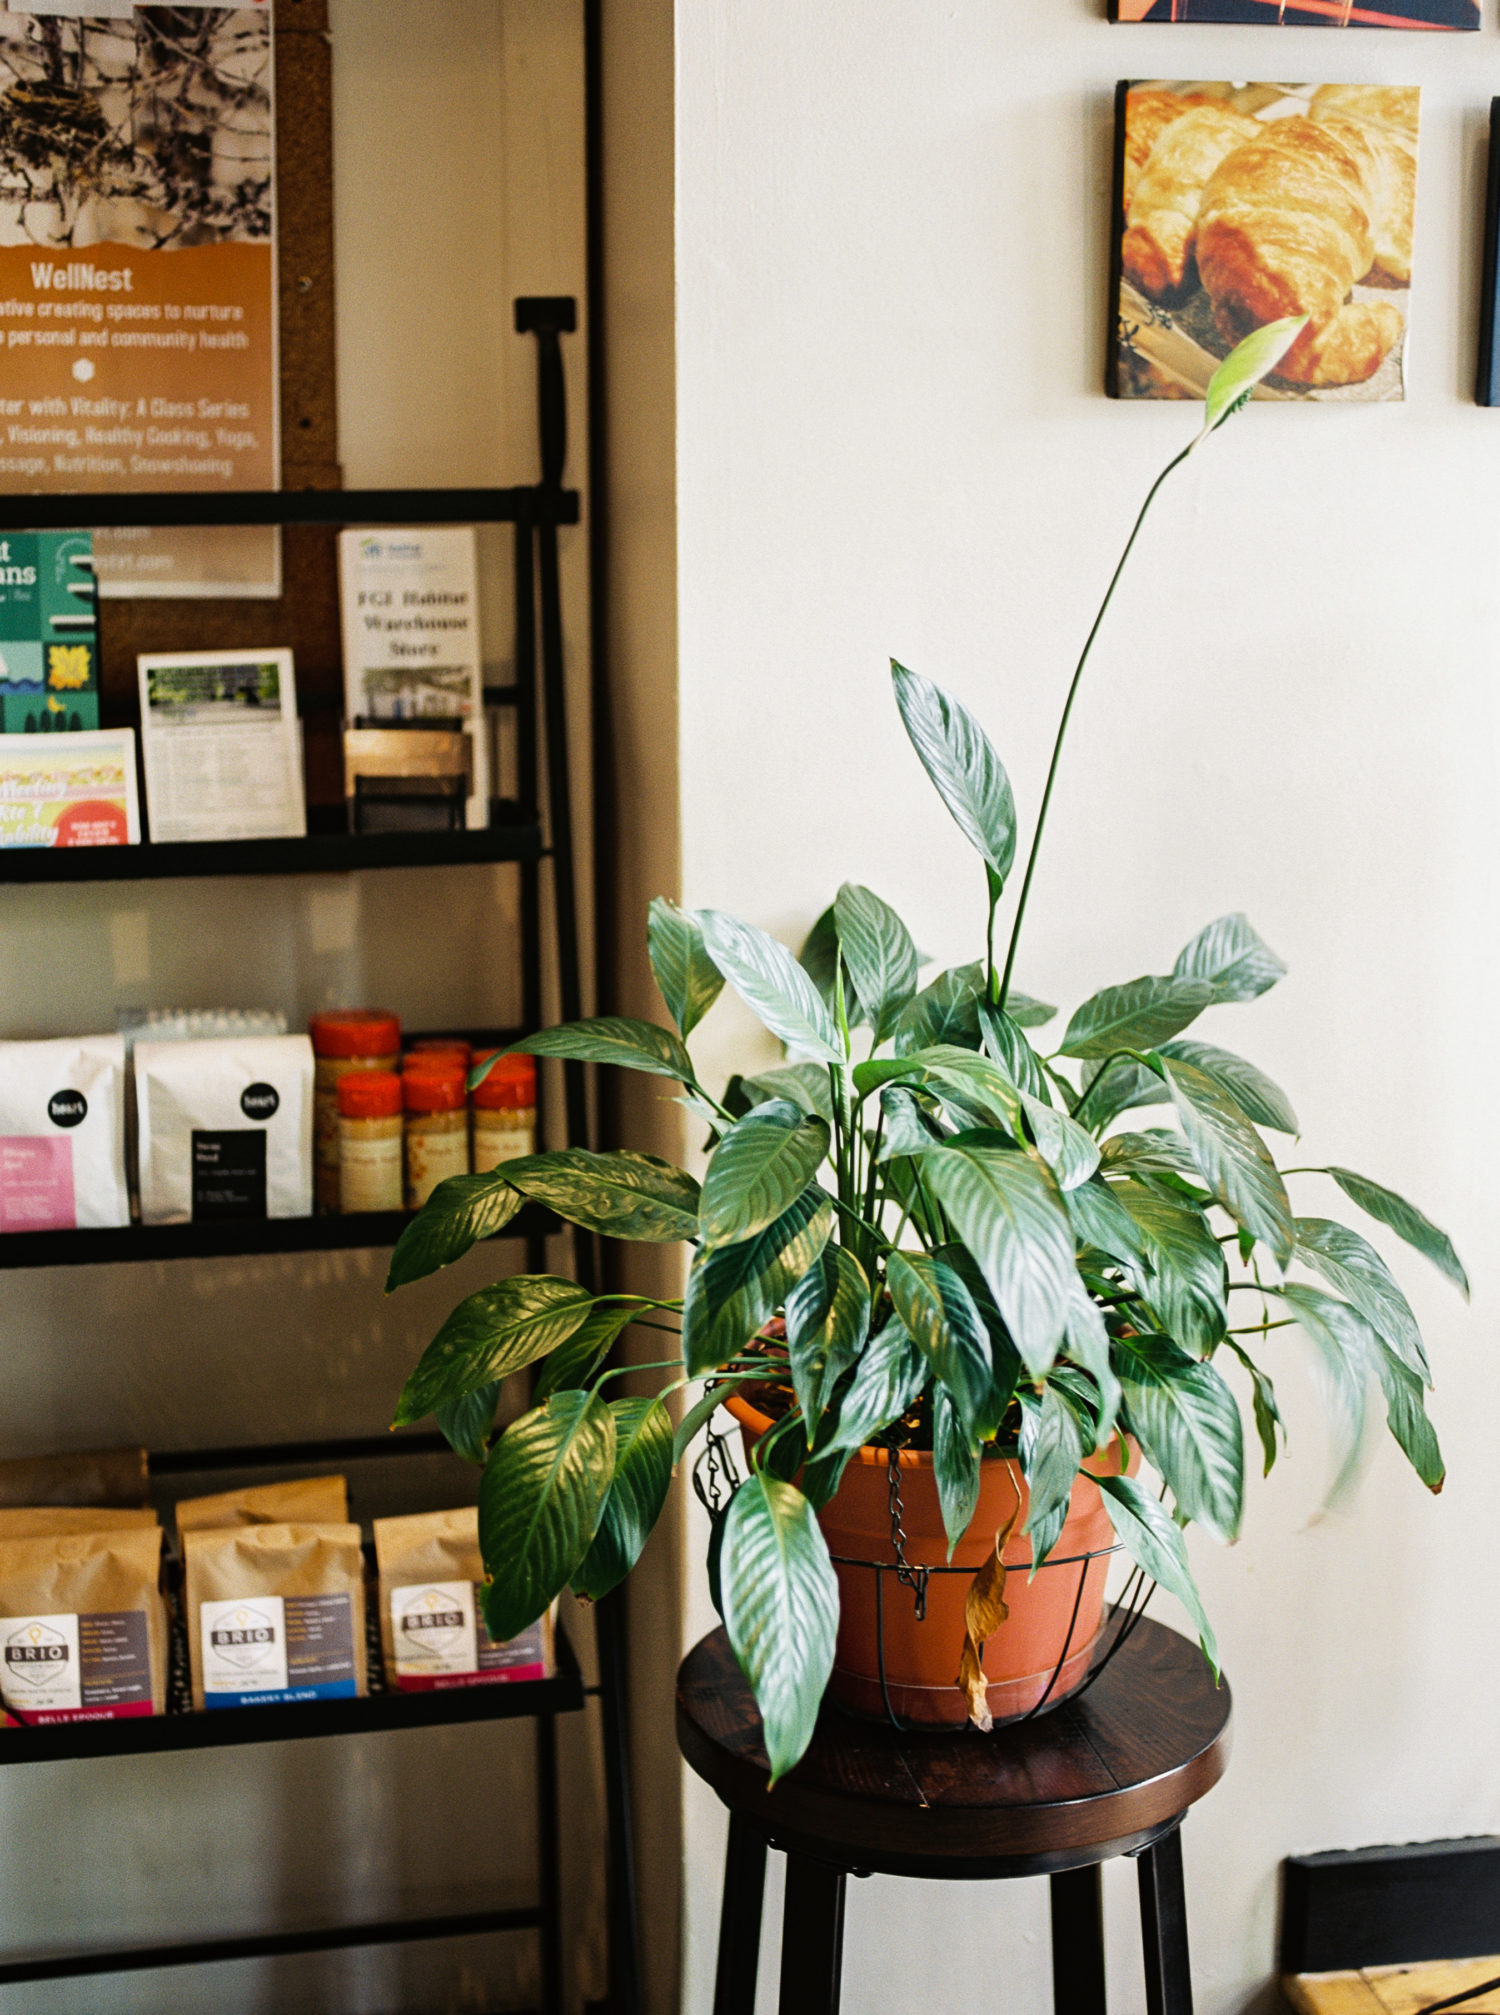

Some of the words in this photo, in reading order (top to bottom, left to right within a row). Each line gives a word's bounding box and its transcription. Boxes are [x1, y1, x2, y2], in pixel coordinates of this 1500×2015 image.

[30, 261, 134, 292] WellNest
[37, 301, 104, 323] creating
[106, 303, 160, 323] spaces
[164, 303, 182, 320] to
[183, 304, 244, 321] nurture
[8, 329, 76, 349] personal
[79, 329, 108, 347] and
[111, 330, 196, 353] community
[198, 331, 249, 350] health
[29, 397, 68, 415] with
[136, 399, 147, 417] A
[150, 399, 196, 418] Class
[197, 398, 250, 419] Series
[84, 426, 144, 449] Healthy
[406, 1613, 460, 1629] BRIO
[216, 1628, 269, 1644] BRIO
[11, 1646, 63, 1661] BRIO
[283, 1690, 318, 1702] BLEND
[37, 1714, 70, 1725] BELLE
